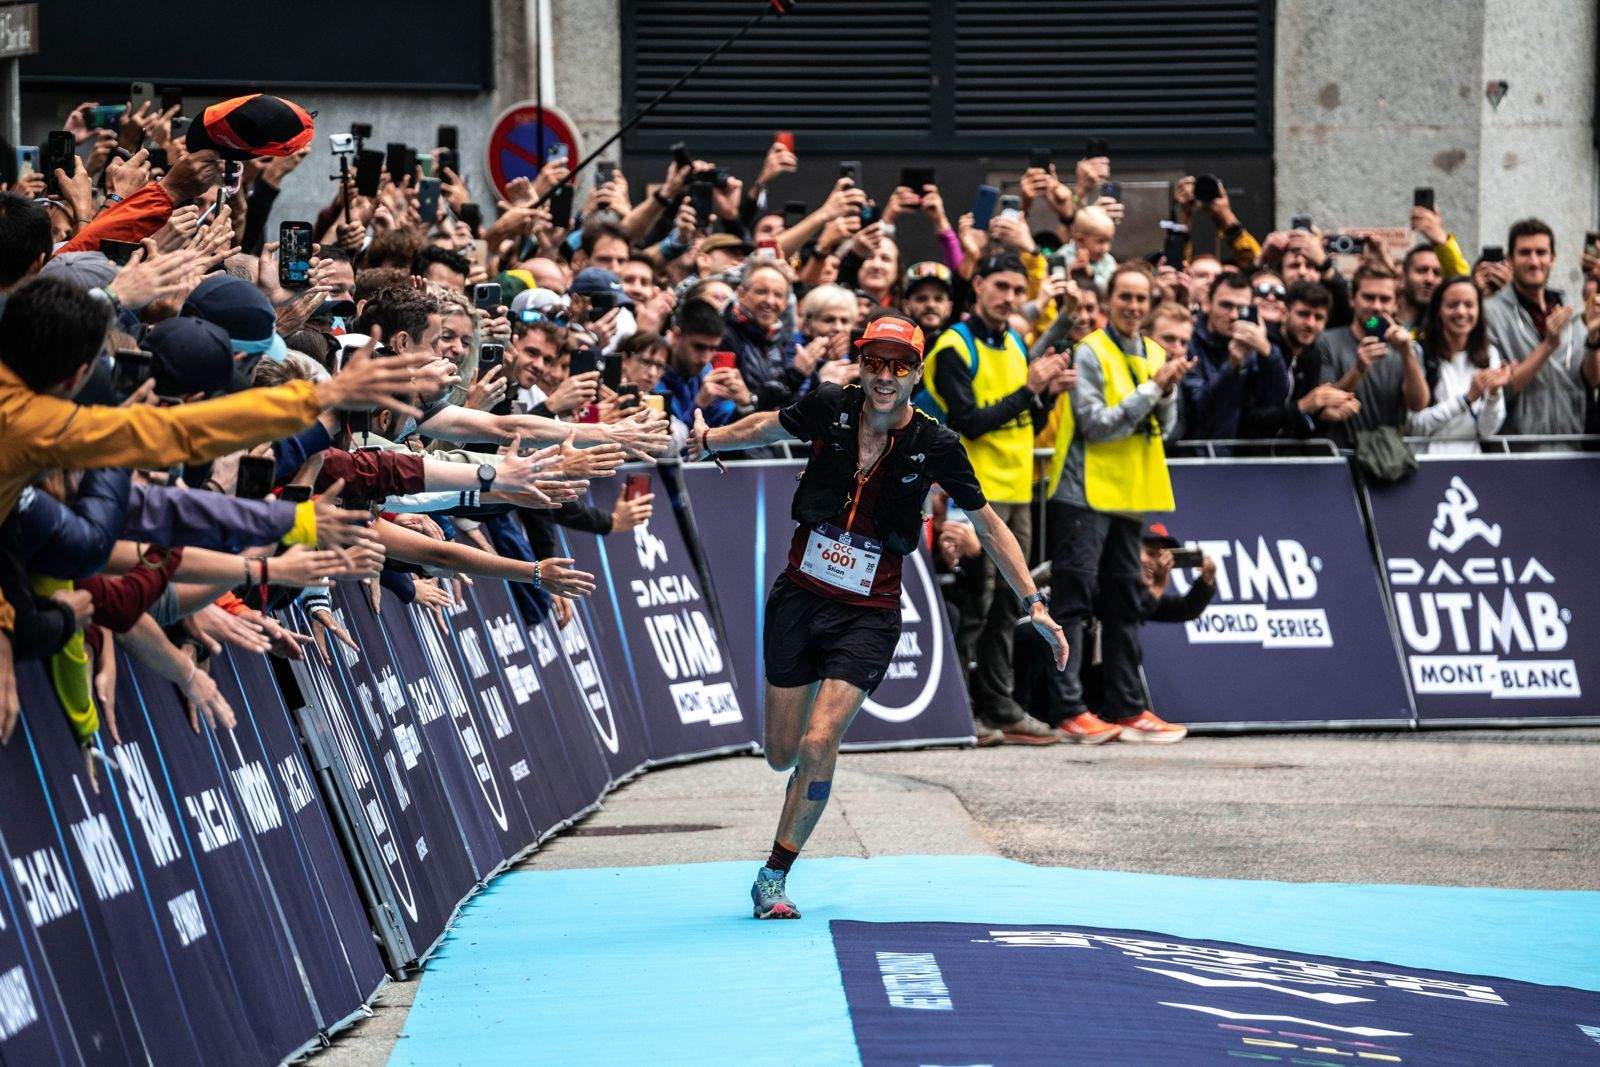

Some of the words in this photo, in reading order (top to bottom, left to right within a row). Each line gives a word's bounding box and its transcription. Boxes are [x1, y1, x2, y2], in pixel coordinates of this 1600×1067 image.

[821, 548, 857, 570] 6001
[833, 542, 853, 556] OCC
[826, 564, 845, 576] Stian
[1387, 557, 1556, 585] DACIA
[1193, 613, 1258, 633] WORLD
[1267, 618, 1324, 638] SERIES
[1395, 587, 1569, 655] UTMB
[644, 608, 723, 680] UTMB
